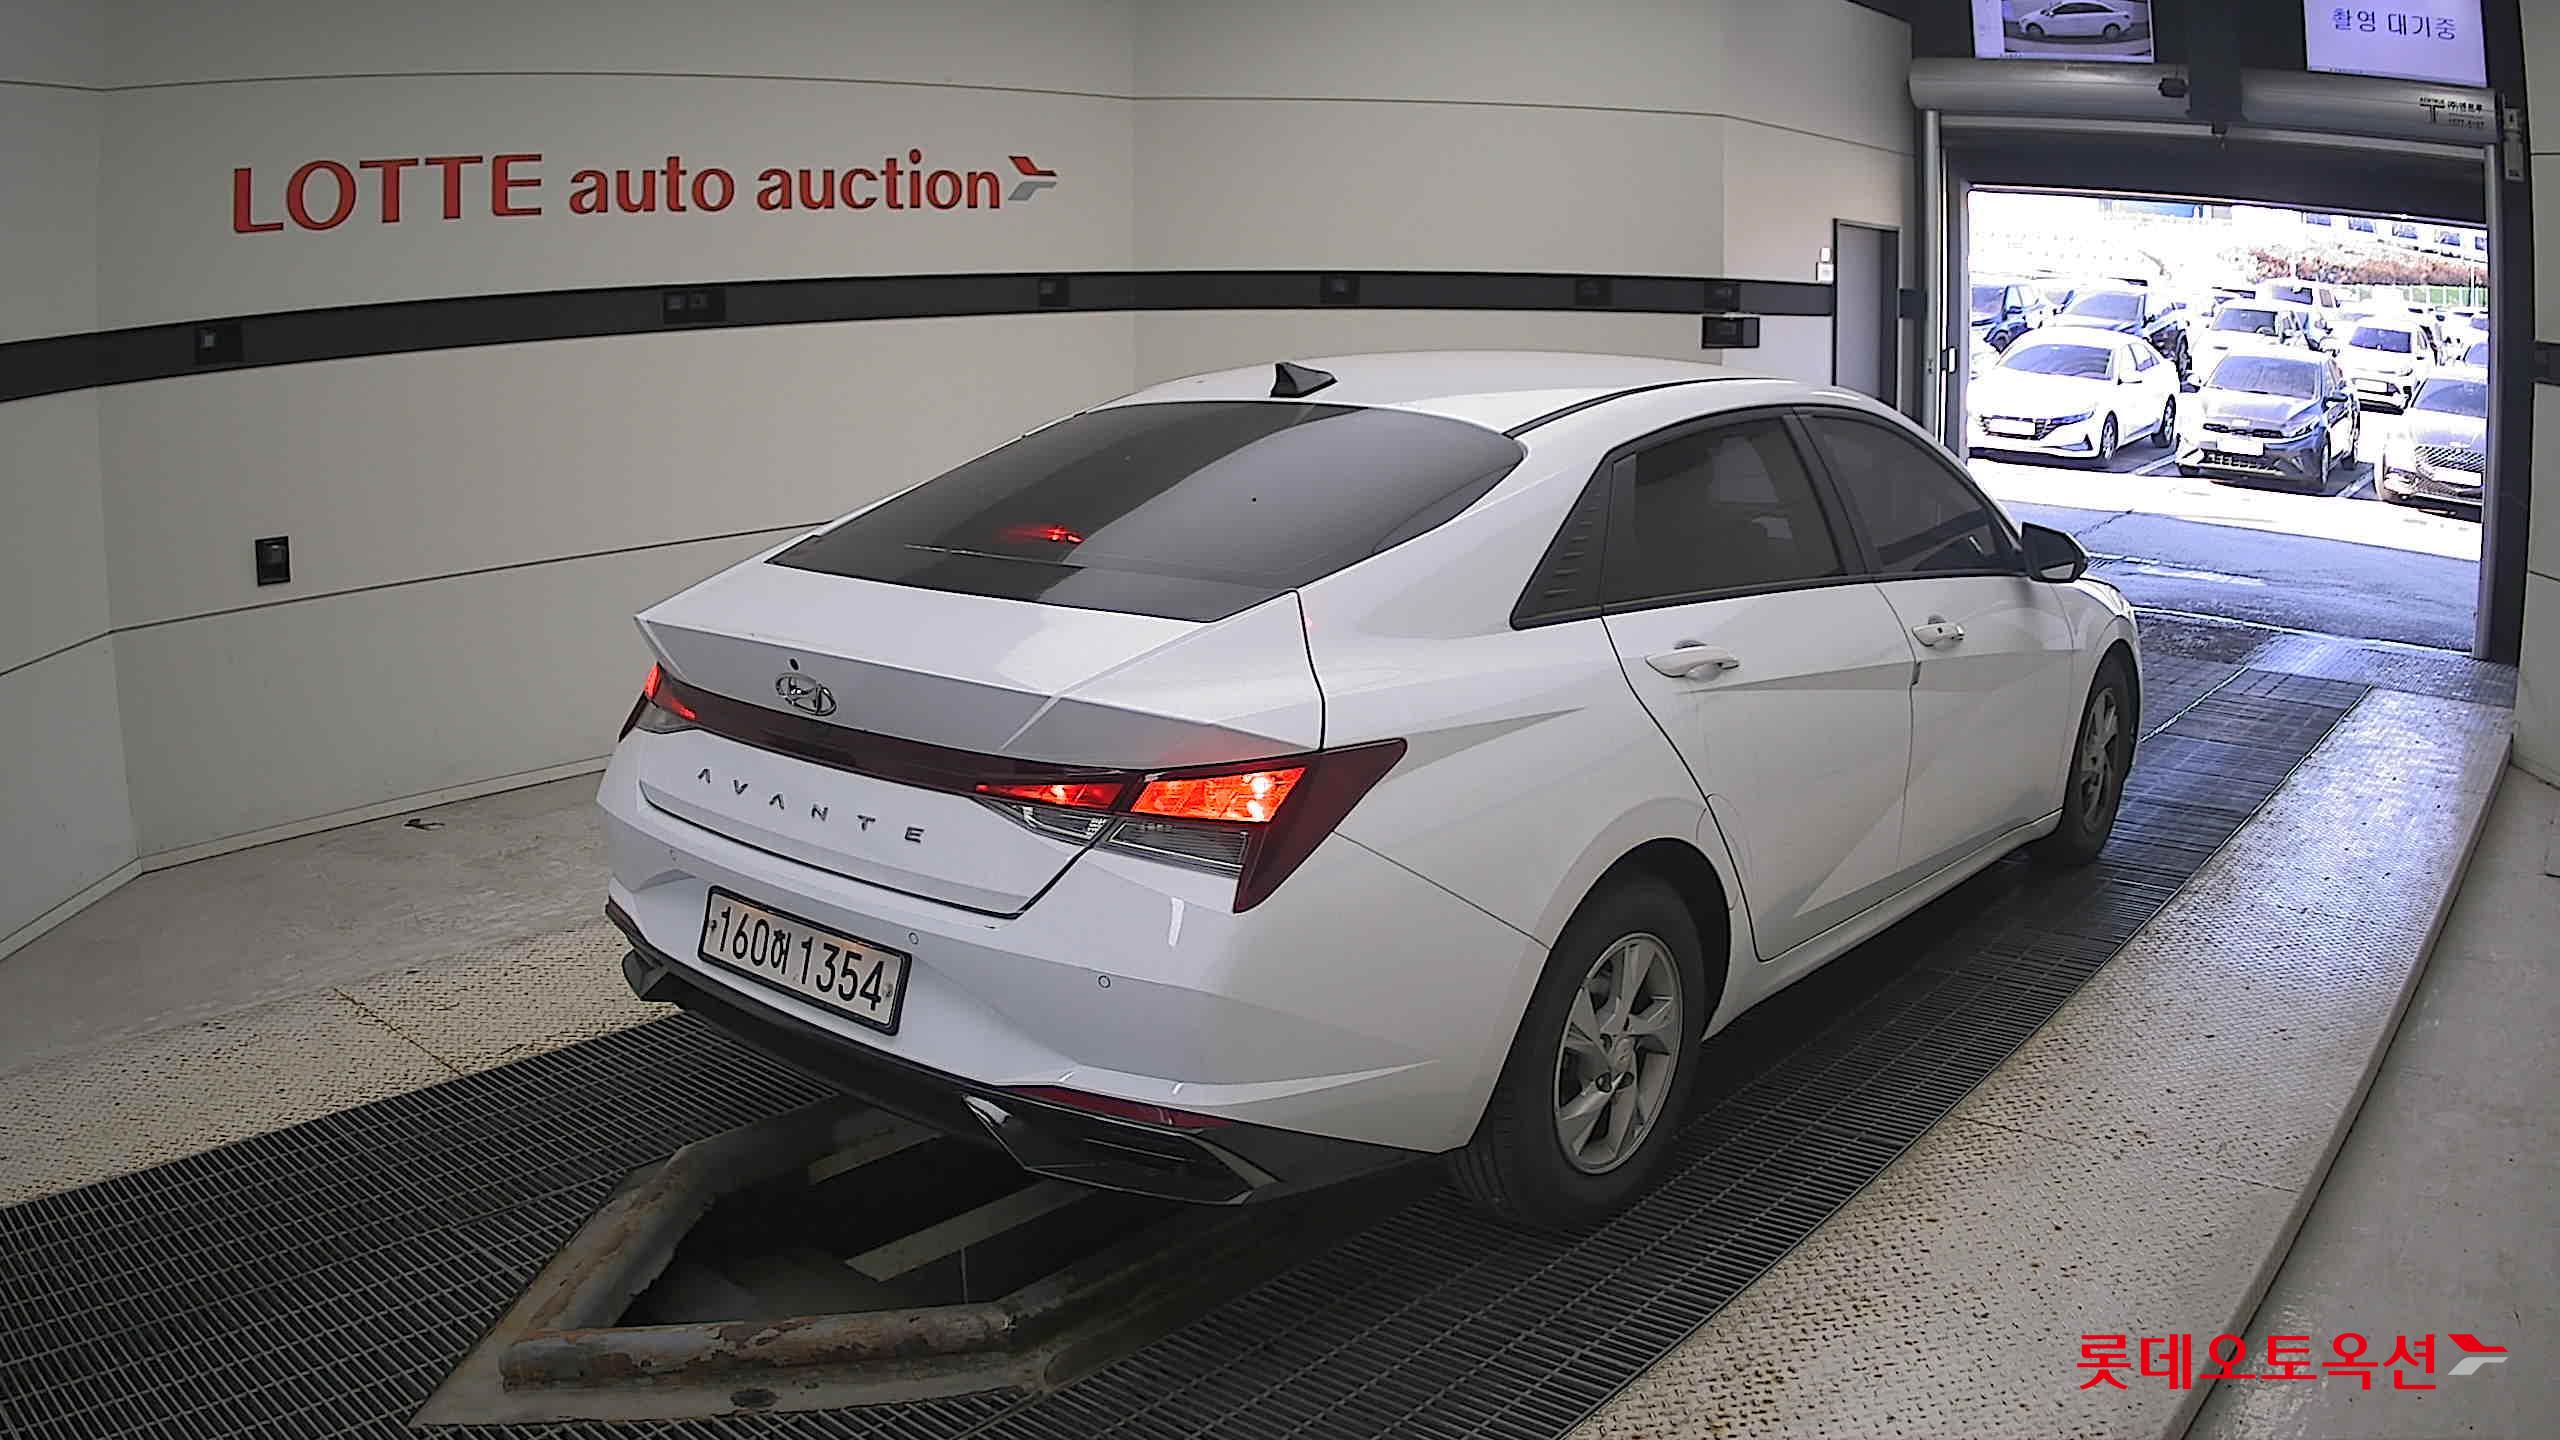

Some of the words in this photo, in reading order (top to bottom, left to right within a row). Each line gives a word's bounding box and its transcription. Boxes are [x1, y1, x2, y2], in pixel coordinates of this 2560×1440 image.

[2333, 8, 2377, 33] 촬영
[2387, 13, 2457, 41] 대기중
[234, 155, 543, 234] LOTTE
[569, 156, 735, 214] auto
[757, 149, 1001, 211] auction
[697, 768, 924, 844] AVANTE
[720, 906, 792, 975] 160허
[801, 936, 885, 1011] 1354
